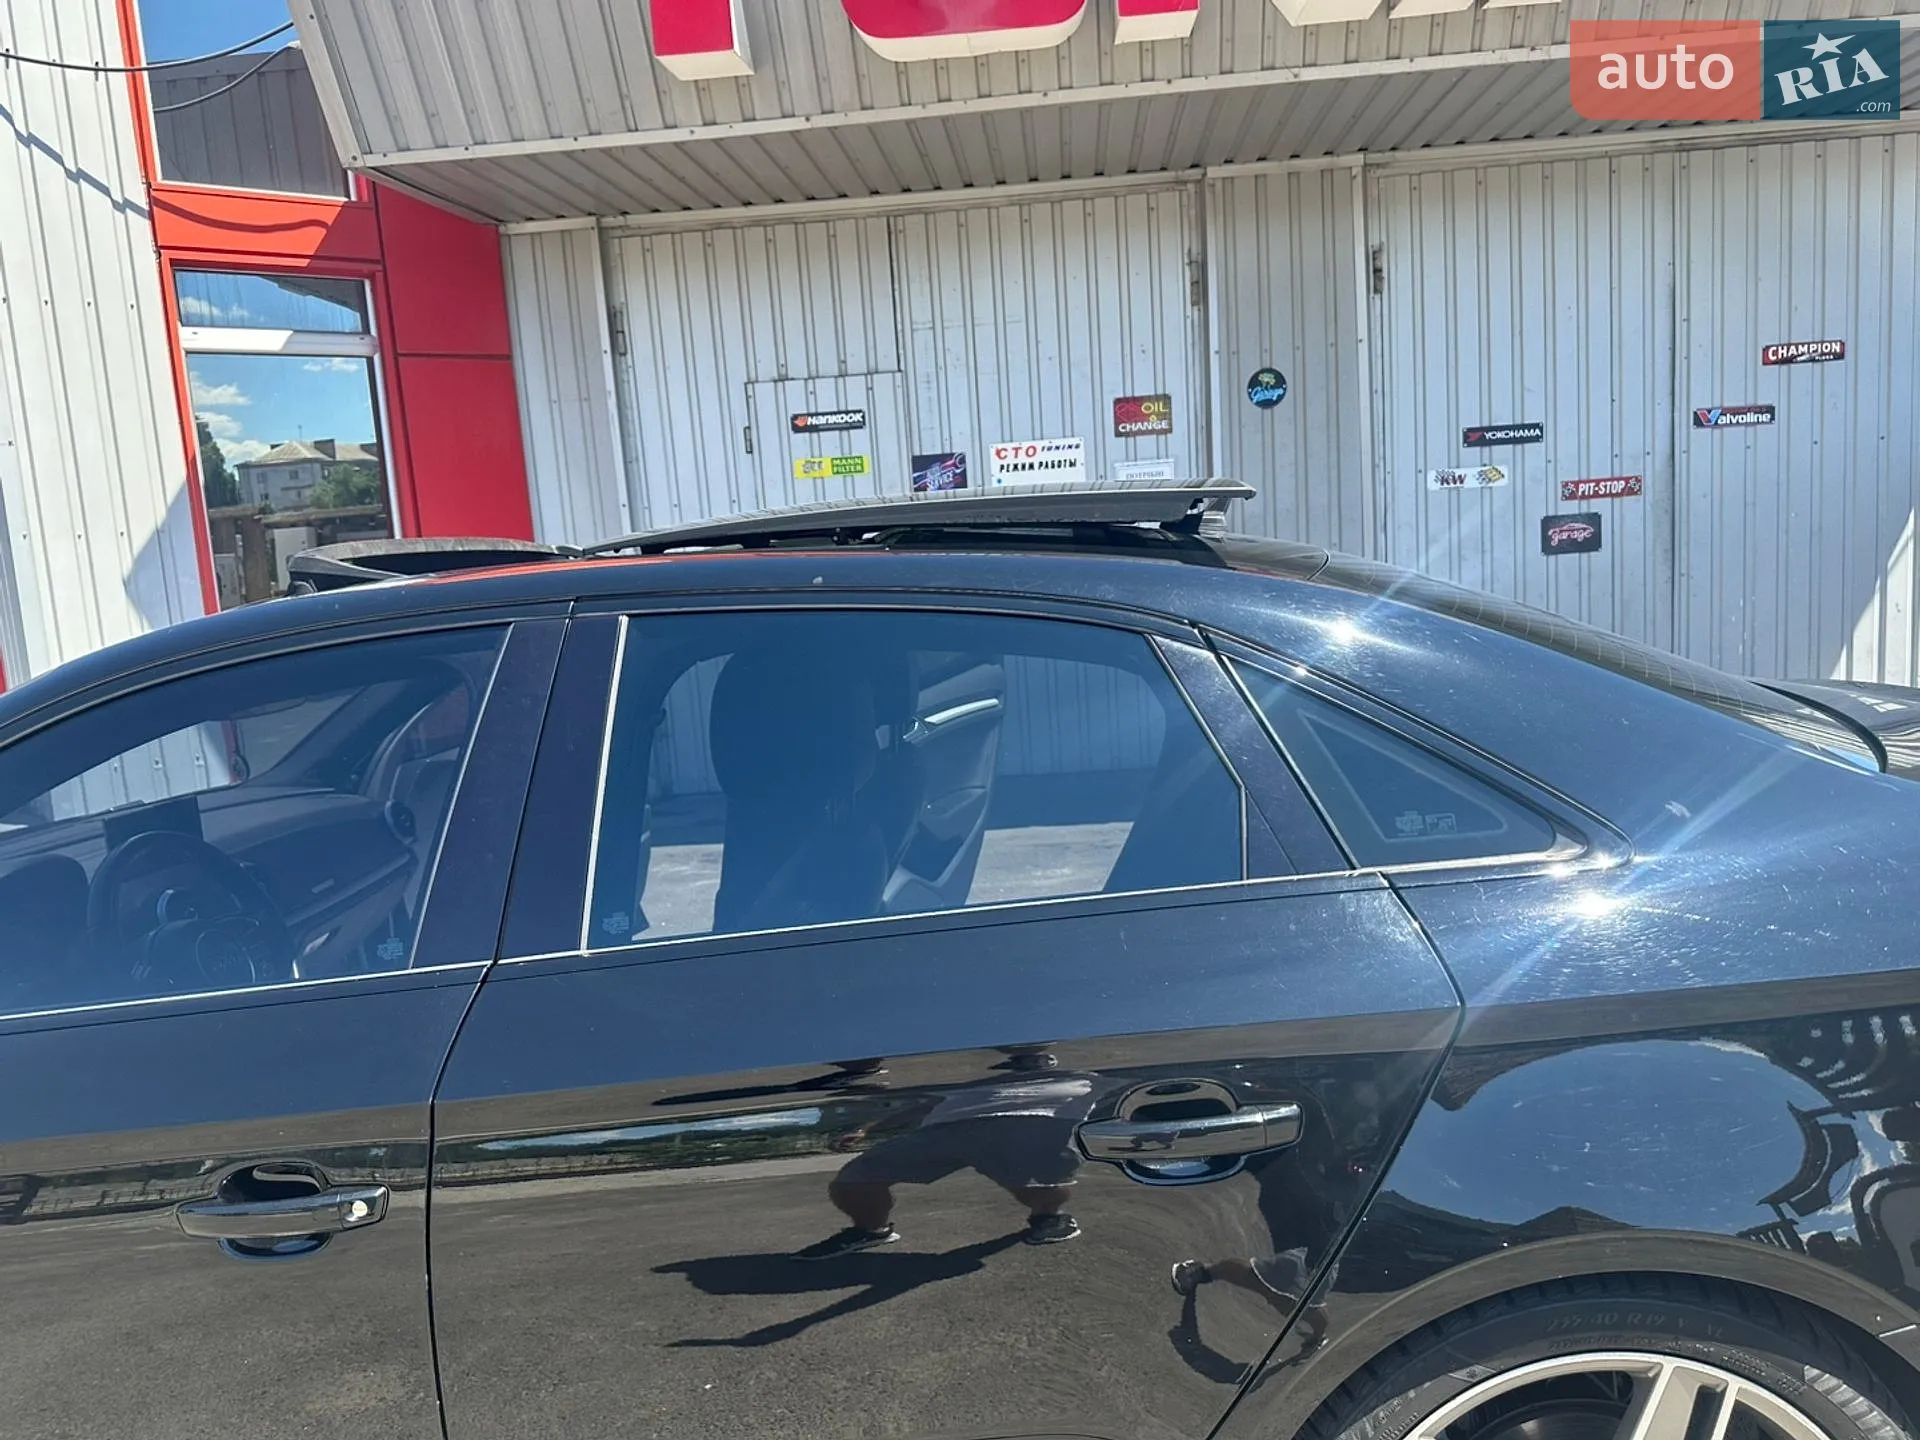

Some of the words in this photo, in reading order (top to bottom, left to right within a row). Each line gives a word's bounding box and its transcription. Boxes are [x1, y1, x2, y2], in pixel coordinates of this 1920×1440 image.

[1767, 341, 1841, 361] CHAMPION
[1141, 401, 1169, 414] OIL
[1696, 407, 1771, 426] Valvoline
[1118, 419, 1170, 432] CHANGE
[1483, 428, 1542, 440] YOKOHAMA
[833, 457, 862, 465] MANN
[999, 461, 1036, 473] РЕЖИМ
[1037, 458, 1078, 471] РАБОТЫ
[1578, 480, 1626, 497] PIT-STOP
